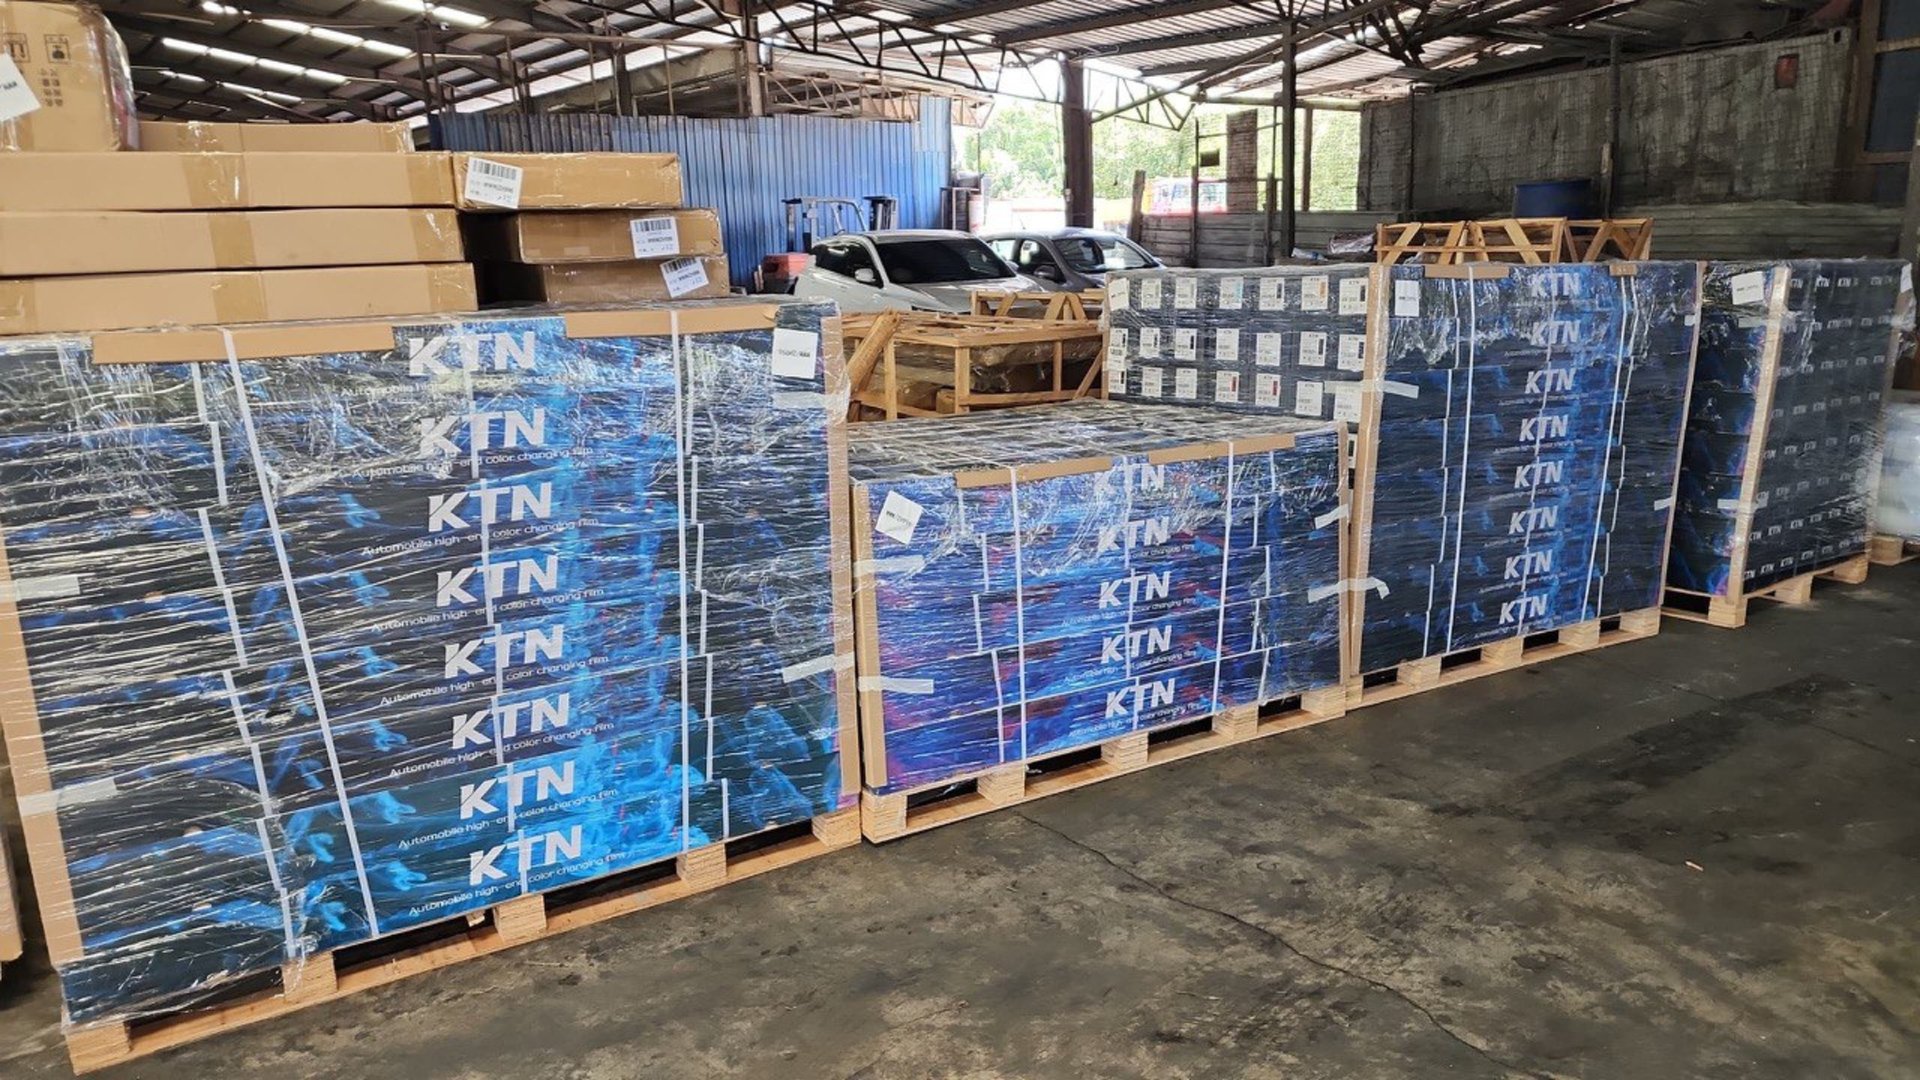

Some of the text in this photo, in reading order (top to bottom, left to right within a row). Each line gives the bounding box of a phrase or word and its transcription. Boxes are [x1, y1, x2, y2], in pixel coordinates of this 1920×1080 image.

[1531, 273, 1580, 297] KTN
[1530, 320, 1581, 345] KTN
[409, 331, 535, 376] KTN
[1525, 368, 1577, 394] KTN
[420, 408, 545, 457] KTN
[1519, 414, 1569, 441] KTN
[352, 463, 424, 479] Automobile
[485, 453, 514, 464] color
[516, 448, 570, 462] changing
[1094, 463, 1165, 495] KTN
[1514, 460, 1563, 488] KTN
[428, 482, 551, 531] KTN
[1509, 505, 1558, 534] KTN
[360, 539, 432, 556] Automobile
[493, 527, 522, 538] color
[524, 520, 575, 534] changing
[578, 517, 599, 527] film
[1098, 516, 1170, 552] KTN
[436, 554, 558, 607] KTN
[1504, 549, 1553, 580] KTN
[1099, 570, 1171, 608] KTN
[371, 613, 441, 632] Automobile
[500, 599, 529, 611] color
[530, 591, 581, 606] changing
[584, 588, 604, 598] film
[1500, 594, 1547, 624] KTN
[445, 624, 564, 678] KTN
[1101, 625, 1173, 664] KTN
[380, 687, 448, 706] Automobile
[506, 670, 533, 682] color
[536, 661, 586, 675] changing
[588, 655, 609, 666] film
[1105, 678, 1175, 718] KTN
[452, 692, 570, 749] KTN
[388, 758, 456, 777] Automobile
[513, 739, 541, 751] color
[543, 729, 593, 744] changing
[594, 722, 614, 733] film
[460, 761, 575, 820] KTN
[399, 825, 464, 850] Automobile
[519, 804, 546, 817] color
[548, 795, 597, 811] changing
[598, 788, 618, 800] film
[470, 824, 582, 886] KTN
[409, 891, 474, 916] Automobile
[528, 870, 555, 883] color
[557, 859, 604, 876] changing
